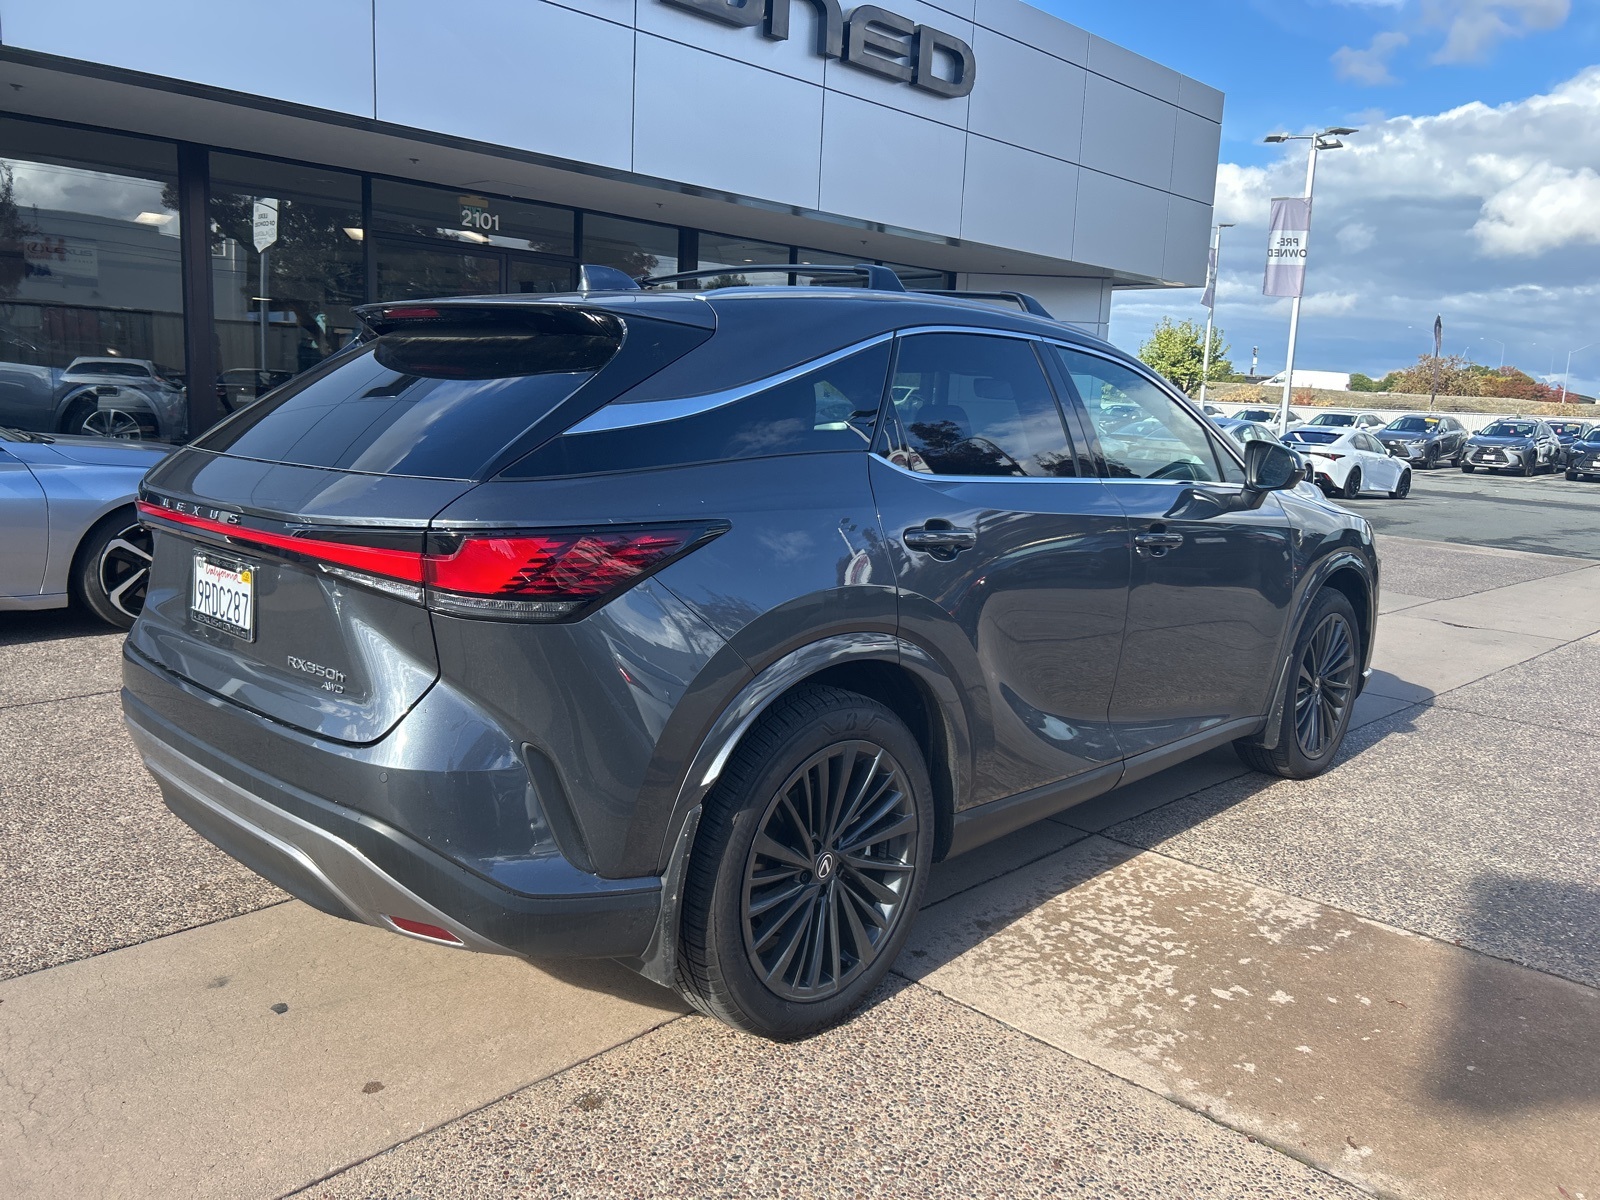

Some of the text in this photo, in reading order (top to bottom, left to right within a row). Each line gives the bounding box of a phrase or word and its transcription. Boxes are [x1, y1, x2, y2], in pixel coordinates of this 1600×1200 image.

[461, 209, 499, 231] 2101
[162, 498, 240, 524] LEXUS
[197, 579, 249, 627] 9RDC287
[321, 681, 345, 694] AWD
